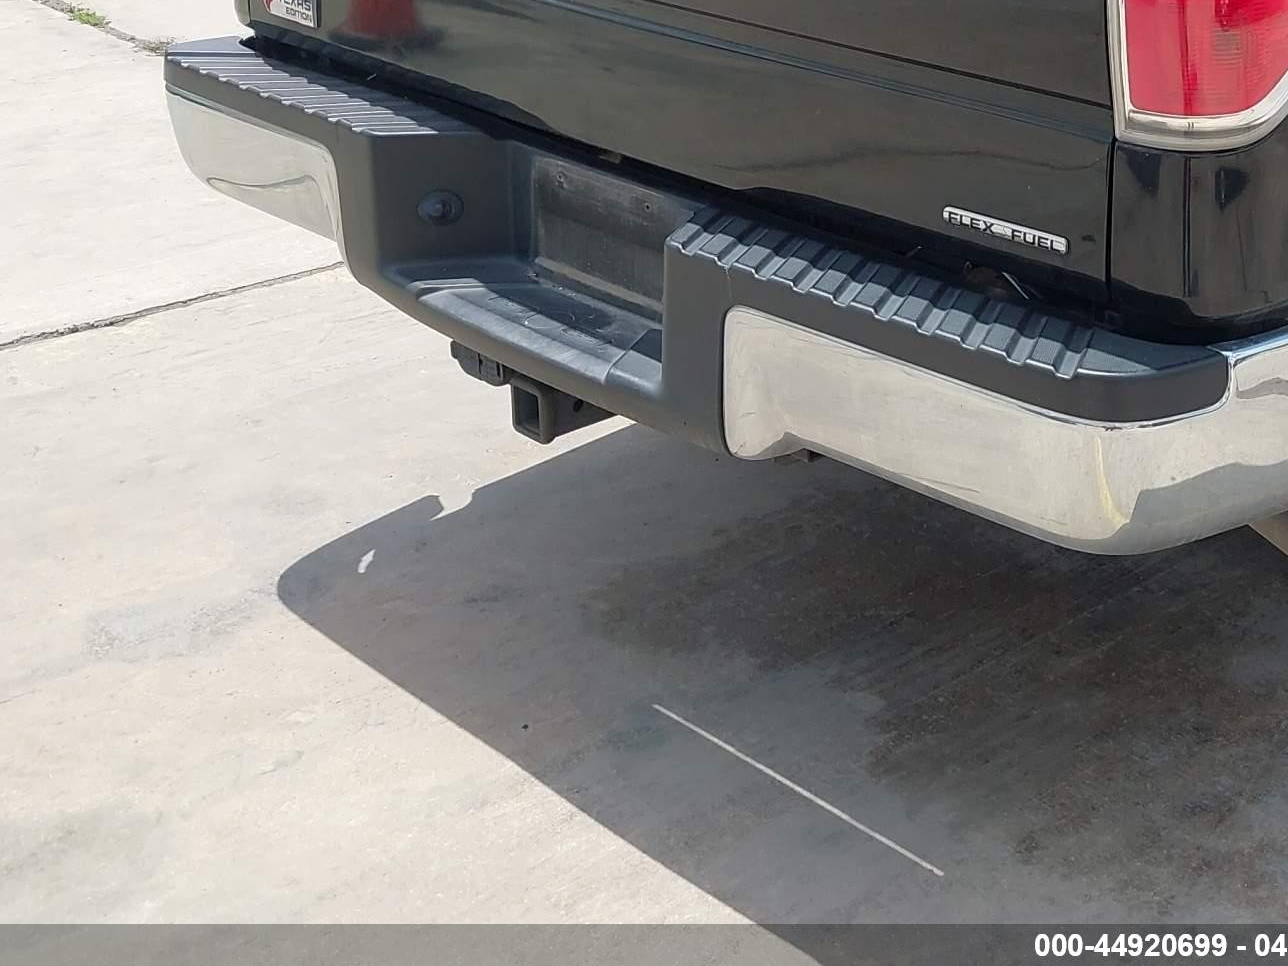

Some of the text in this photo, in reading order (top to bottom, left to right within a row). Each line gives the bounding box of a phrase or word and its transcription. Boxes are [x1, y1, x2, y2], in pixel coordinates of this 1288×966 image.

[285, 6, 313, 23] EDITION
[946, 209, 1067, 255] FLEX FUEL
